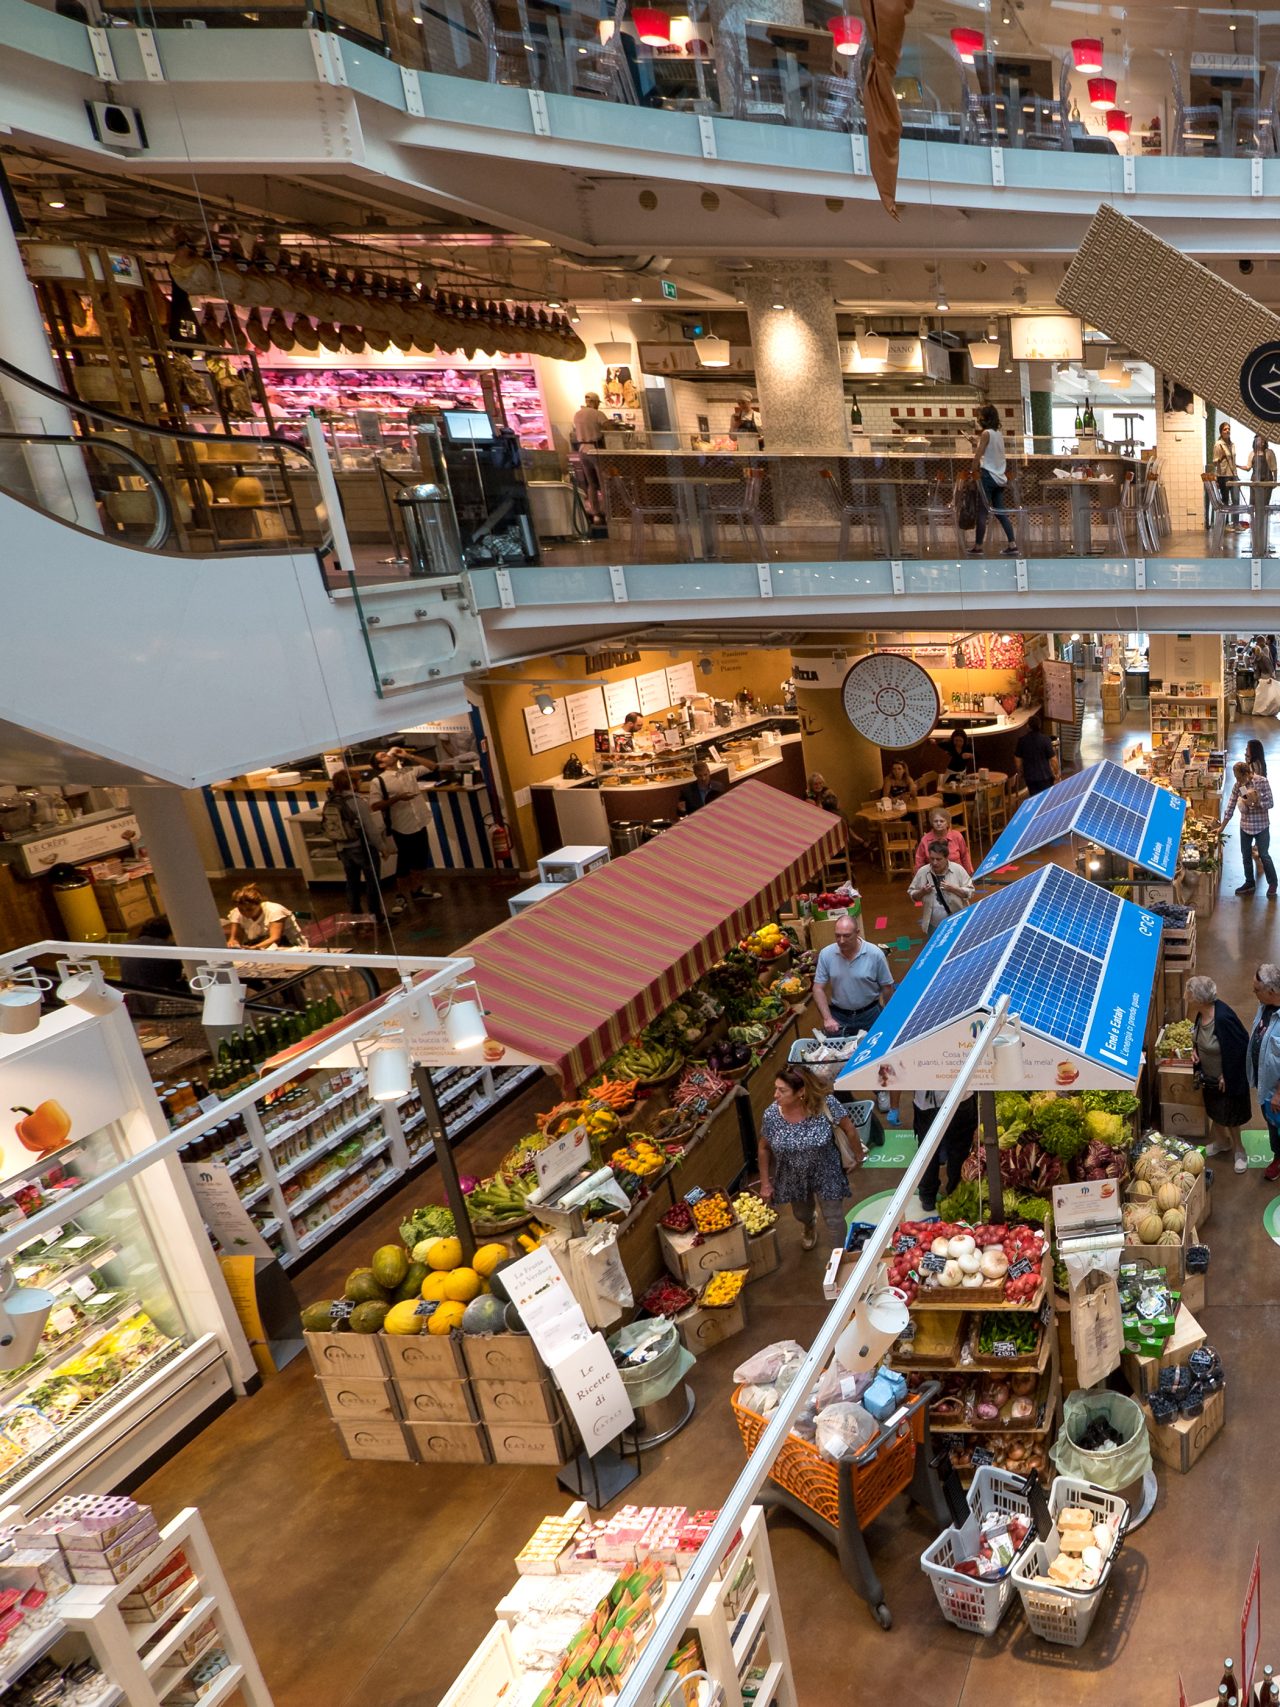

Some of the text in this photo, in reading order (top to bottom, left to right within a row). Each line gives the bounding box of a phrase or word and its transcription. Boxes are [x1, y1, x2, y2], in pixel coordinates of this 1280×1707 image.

[1137, 912, 1152, 937] enel
[1110, 1006, 1126, 1029] Eataly
[1105, 1031, 1119, 1051] Enel
[869, 1154, 905, 1163] ene
[1246, 1154, 1273, 1165] nel
[580, 1364, 594, 1379] Le
[576, 1371, 612, 1402] Ricette
[594, 1393, 606, 1408] di
